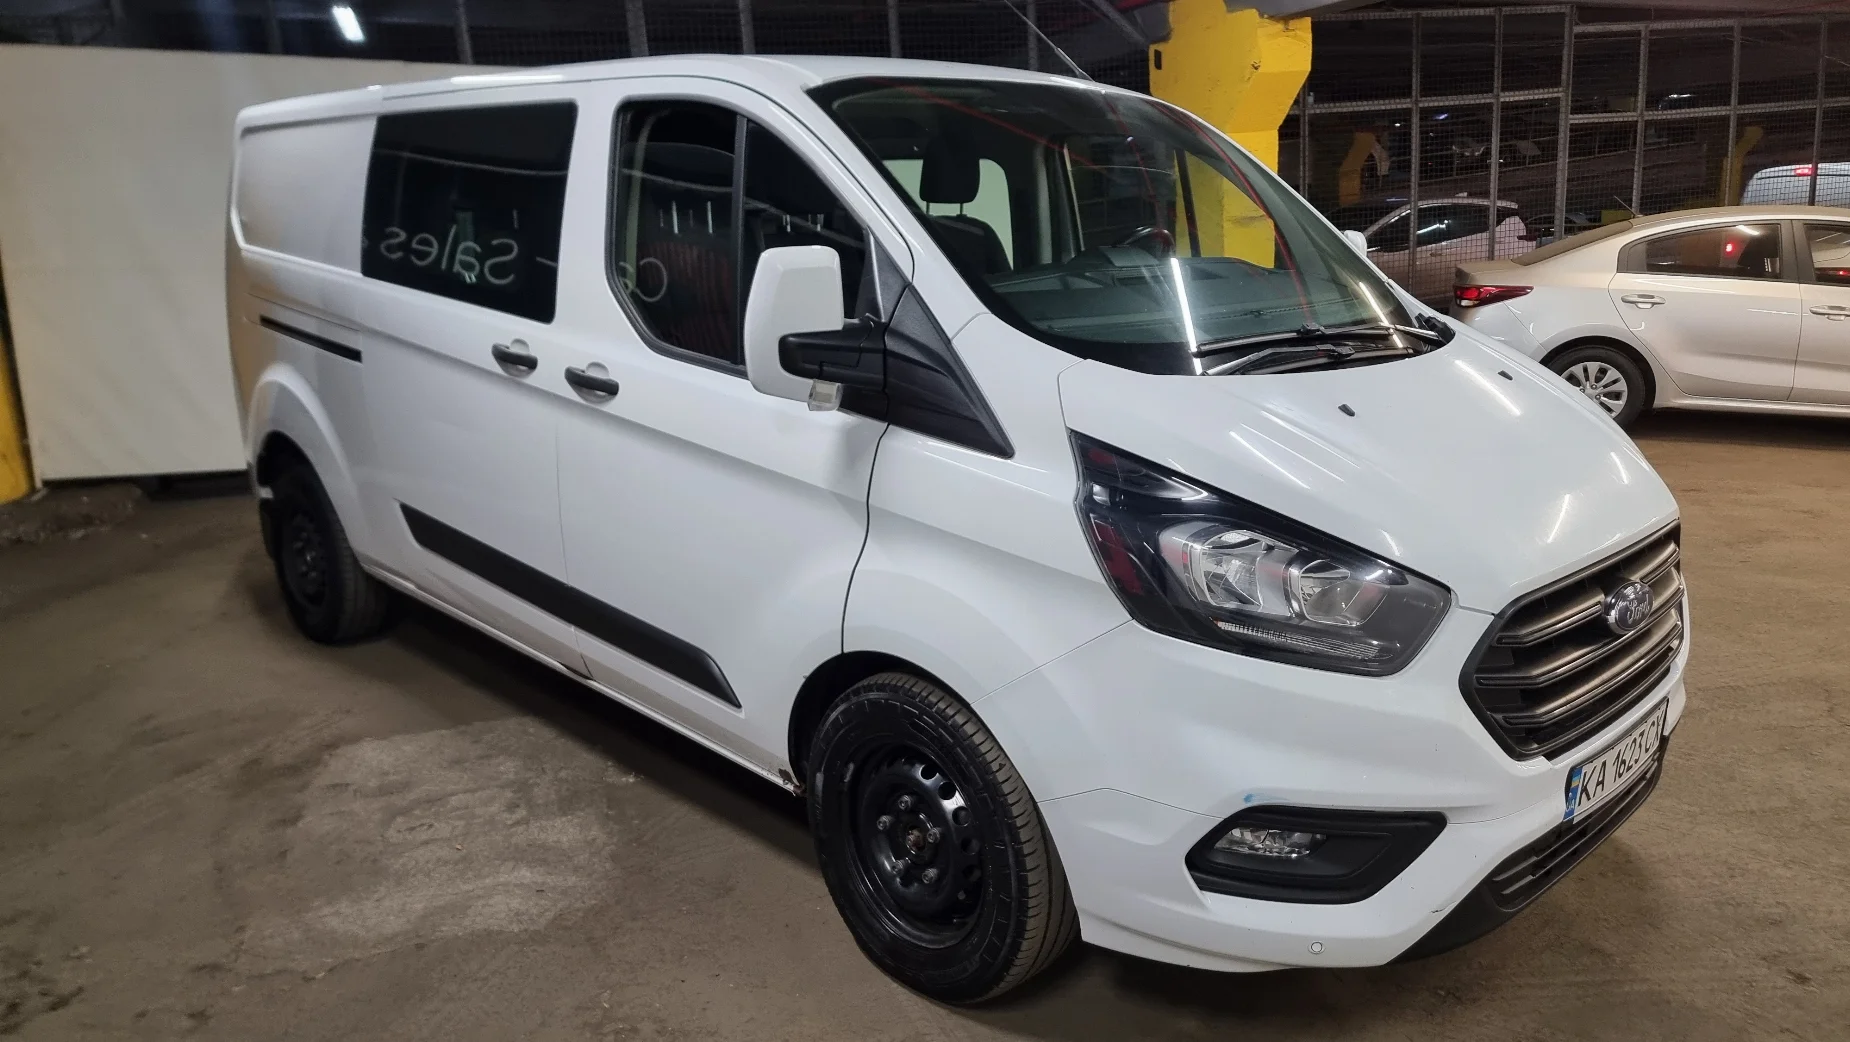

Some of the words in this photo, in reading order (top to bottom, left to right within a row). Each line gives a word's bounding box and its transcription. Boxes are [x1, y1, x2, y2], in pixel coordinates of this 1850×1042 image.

[1615, 593, 1650, 624] Ford
[1578, 760, 1607, 807] KA
[1612, 728, 1646, 784] 1623
[1644, 708, 1665, 754] CX
